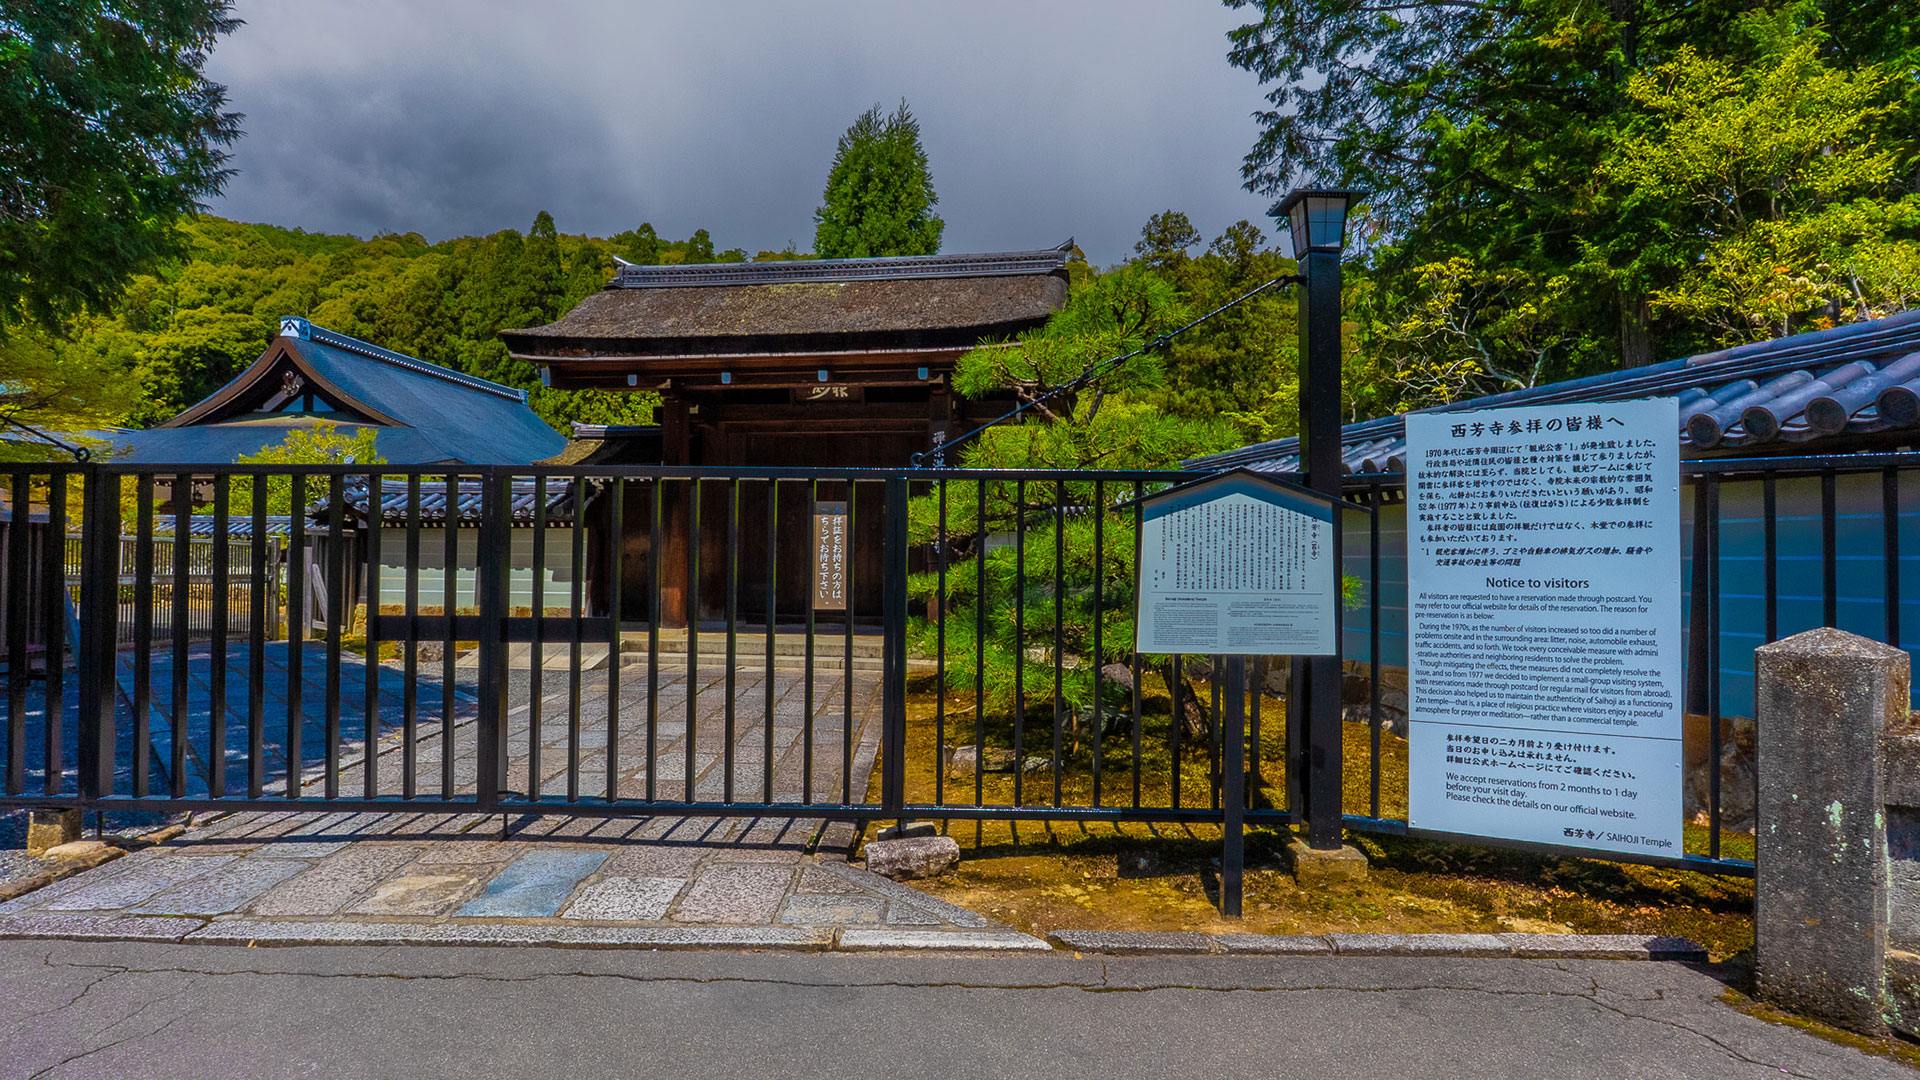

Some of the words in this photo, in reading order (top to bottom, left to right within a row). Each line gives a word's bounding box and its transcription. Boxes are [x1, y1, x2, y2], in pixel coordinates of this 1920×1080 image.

[1451, 413, 1624, 438] 西芳寺参拝の皆様へ
[1418, 511, 1517, 521] 実施することと致しました。
[1419, 534, 1517, 542] も参加いただいております。
[1486, 577, 1524, 587] Notice
[1527, 578, 1540, 587] to
[1543, 578, 1589, 588] visitors
[1460, 593, 1490, 602] requested
[1577, 594, 1604, 603] through
[1605, 594, 1636, 604] postcard.
[1638, 594, 1651, 602] You
[1483, 602, 1507, 610] website
[1415, 611, 1458, 620] pre-reservation
[1419, 622, 1439, 631] During
[1548, 625, 1578, 633] increased
[1620, 627, 1647, 635] number
[1415, 631, 1442, 641] problems
[1494, 633, 1532, 643] surrounding
[1550, 635, 1566, 643] litter,
[1568, 636, 1587, 644] noise,
[1588, 636, 1627, 644] automobile
[1628, 637, 1657, 646] exhaust,
[1432, 641, 1461, 650] accidents,
[1528, 646, 1546, 654] every
[1547, 645, 1586, 653] conceivable
[1617, 647, 1632, 655] with
[1439, 651, 1471, 659] authorities
[1485, 652, 1523, 662] neighboring
[1524, 654, 1553, 662] residents
[1563, 655, 1579, 663] solve
[1593, 656, 1623, 666] problem.
[1419, 659, 1441, 669] Though
[1443, 661, 1473, 670] mitigating
[1584, 666, 1621, 676] completely
[1623, 667, 1647, 675] resolve
[1649, 668, 1660, 676] the
[1494, 672, 1519, 680] decided
[1529, 673, 1564, 684] implement
[1570, 675, 1610, 686] small-group
[1611, 677, 1636, 687] visiting
[1637, 679, 1663, 688] system,
[1429, 679, 1464, 687] reservations
[1466, 680, 1483, 688] made
[1484, 681, 1509, 691] through
[1510, 682, 1538, 692] postcard
[1549, 684, 1572, 694] regular
[1574, 685, 1588, 693] mail
[1625, 687, 1641, 695] from
[1643, 688, 1672, 699] abroad).
[1427, 687, 1452, 695] decision
[1466, 689, 1487, 699] helped
[1505, 692, 1532, 700] maintain
[1546, 693, 1585, 704] authenticity
[1594, 696, 1616, 706] Saihoji
[1632, 697, 1672, 709] functioning
[1415, 705, 1450, 716] atmosphere
[1460, 710, 1480, 718] prayer
[1551, 713, 1565, 721] than
[1572, 714, 1611, 724] commercial
[1612, 716, 1638, 727] temple.
[1481, 700, 1497, 709] place
[1506, 701, 1533, 711] religious
[1534, 703, 1559, 713] practice
[1561, 704, 1581, 712] where
[1583, 706, 1606, 714] visitors
[1607, 707, 1627, 717] enjoy
[1633, 708, 1662, 719] peaceful
[1446, 744, 1576, 763] 当日のお申し込みは承れません。
[1446, 755, 1636, 780] 詳細は公式ホームページにてご確認ください。
[1445, 781, 1471, 791] before
[1472, 786, 1490, 795] your
[1492, 786, 1508, 795] visit
[1510, 787, 1527, 799] day.
[1446, 772, 1459, 781] We
[1460, 774, 1486, 786] accept
[1488, 776, 1536, 788] reservations
[1538, 780, 1558, 790] from
[1560, 782, 1565, 790] 2
[1567, 782, 1600, 793] months
[1602, 786, 1611, 794] to
[1614, 786, 1618, 795] 1
[1621, 787, 1637, 799] day
[1446, 792, 1470, 802] Please
[1471, 794, 1495, 804] check
[1496, 796, 1510, 806] the
[1511, 798, 1538, 808] details
[1569, 803, 1597, 814] official
[1599, 806, 1635, 818] website.
[1607, 832, 1638, 843] SAIHOJI
[1640, 836, 1671, 849] Temple
